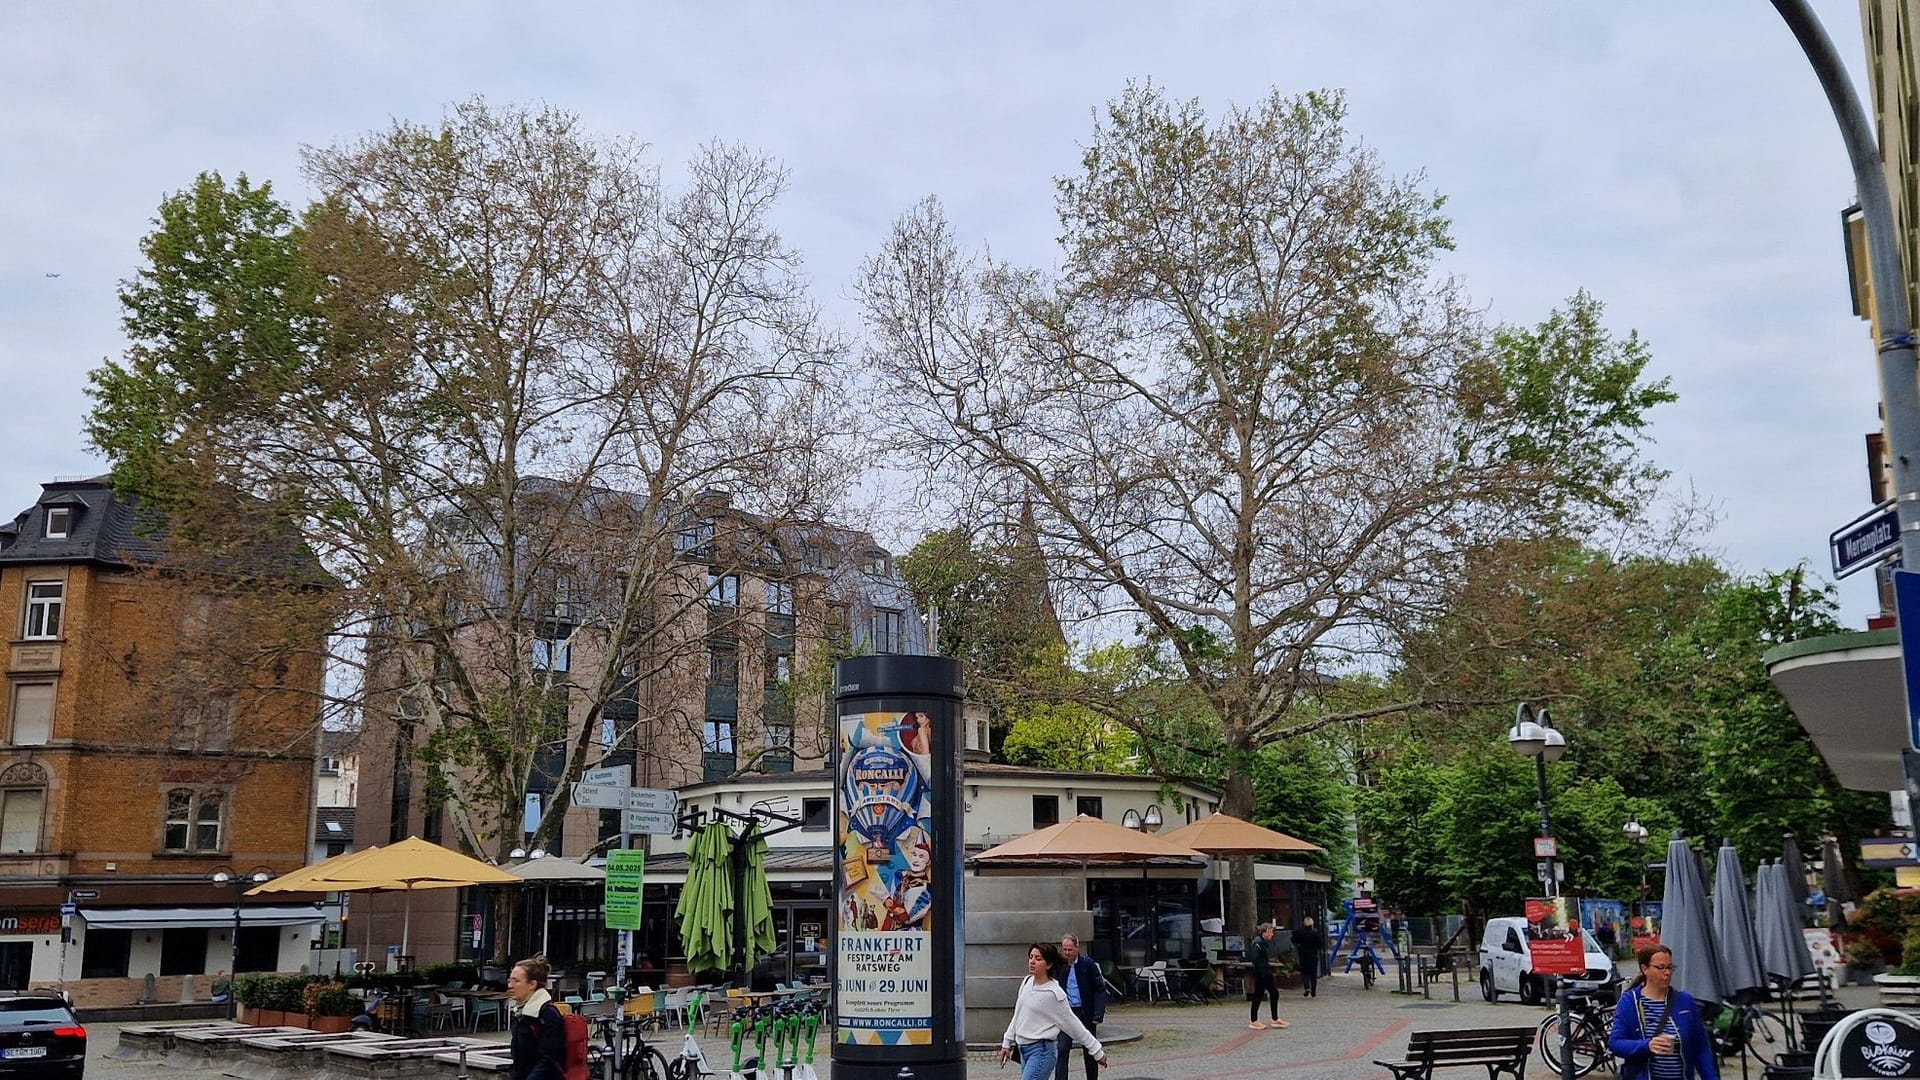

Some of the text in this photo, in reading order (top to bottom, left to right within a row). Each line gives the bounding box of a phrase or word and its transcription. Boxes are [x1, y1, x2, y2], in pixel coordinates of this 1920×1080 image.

[1845, 522, 1893, 560] Merianplatz
[855, 768, 904, 780] RONCALLI
[841, 937, 923, 951] FRANKFURT
[847, 953, 913, 962] FESTPLATZ AM
[856, 963, 900, 972] RATSWEG
[846, 979, 866, 992] JUNI
[879, 979, 898, 993] 29.
[901, 979, 928, 993] JUNI
[852, 1018, 928, 1028] WWW.RONCALLI.DE
